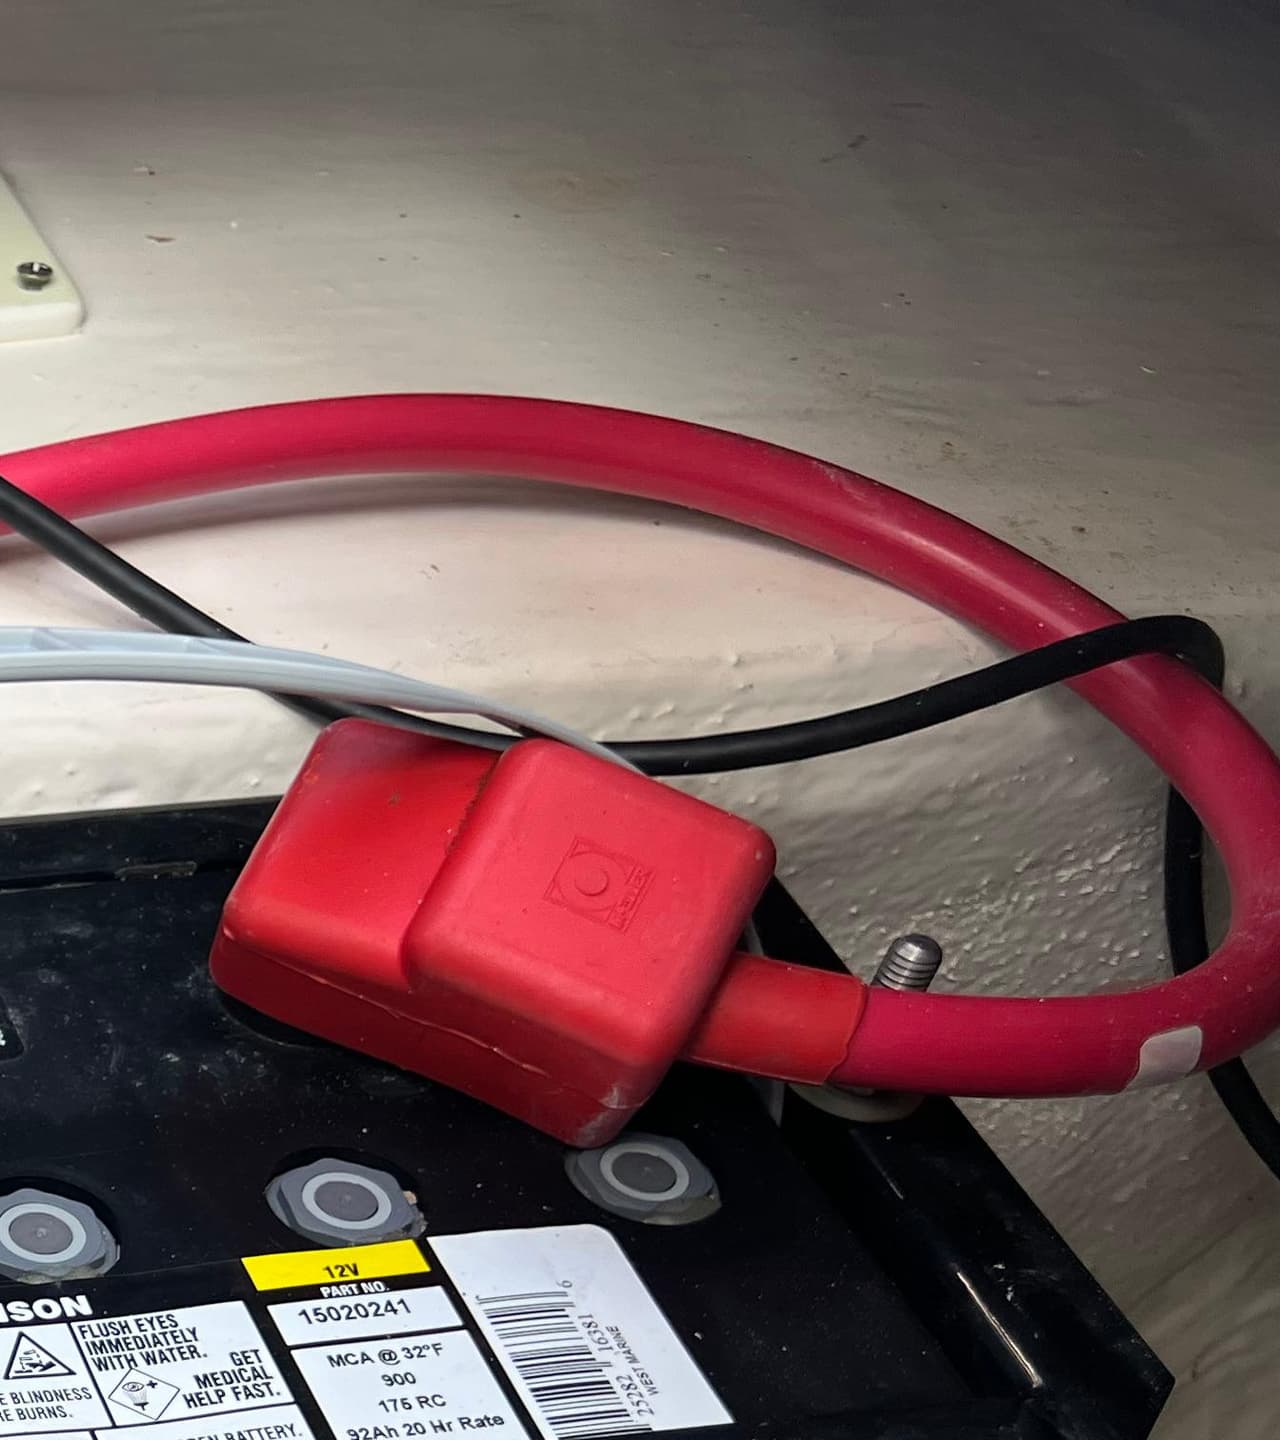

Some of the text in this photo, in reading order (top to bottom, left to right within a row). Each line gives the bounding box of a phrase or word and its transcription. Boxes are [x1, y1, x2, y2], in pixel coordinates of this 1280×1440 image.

[323, 1263, 359, 1280] 12V
[320, 1281, 390, 1298] PART NO.
[298, 1298, 411, 1325] 15020241
[78, 1314, 179, 1339] FLUSH EYES
[84, 1327, 200, 1356] IMMEDIATELY
[90, 1345, 208, 1373] WITH WATER.
[229, 1350, 263, 1367] GET
[327, 1343, 444, 1368] MCA @ 32°F
[606, 1326, 659, 1396] WEST MARINE
[193, 1366, 274, 1389] MEDICAL
[381, 1372, 416, 1387] 900
[10, 1386, 93, 1405] BLINDNESS
[183, 1382, 281, 1409] HELP FAST.
[378, 1394, 447, 1413] 175 RC
[16, 1405, 74, 1421] BURNS.
[403, 1421, 426, 1436] 20
[429, 1419, 454, 1433] Hr
[457, 1414, 504, 1431] Rate
